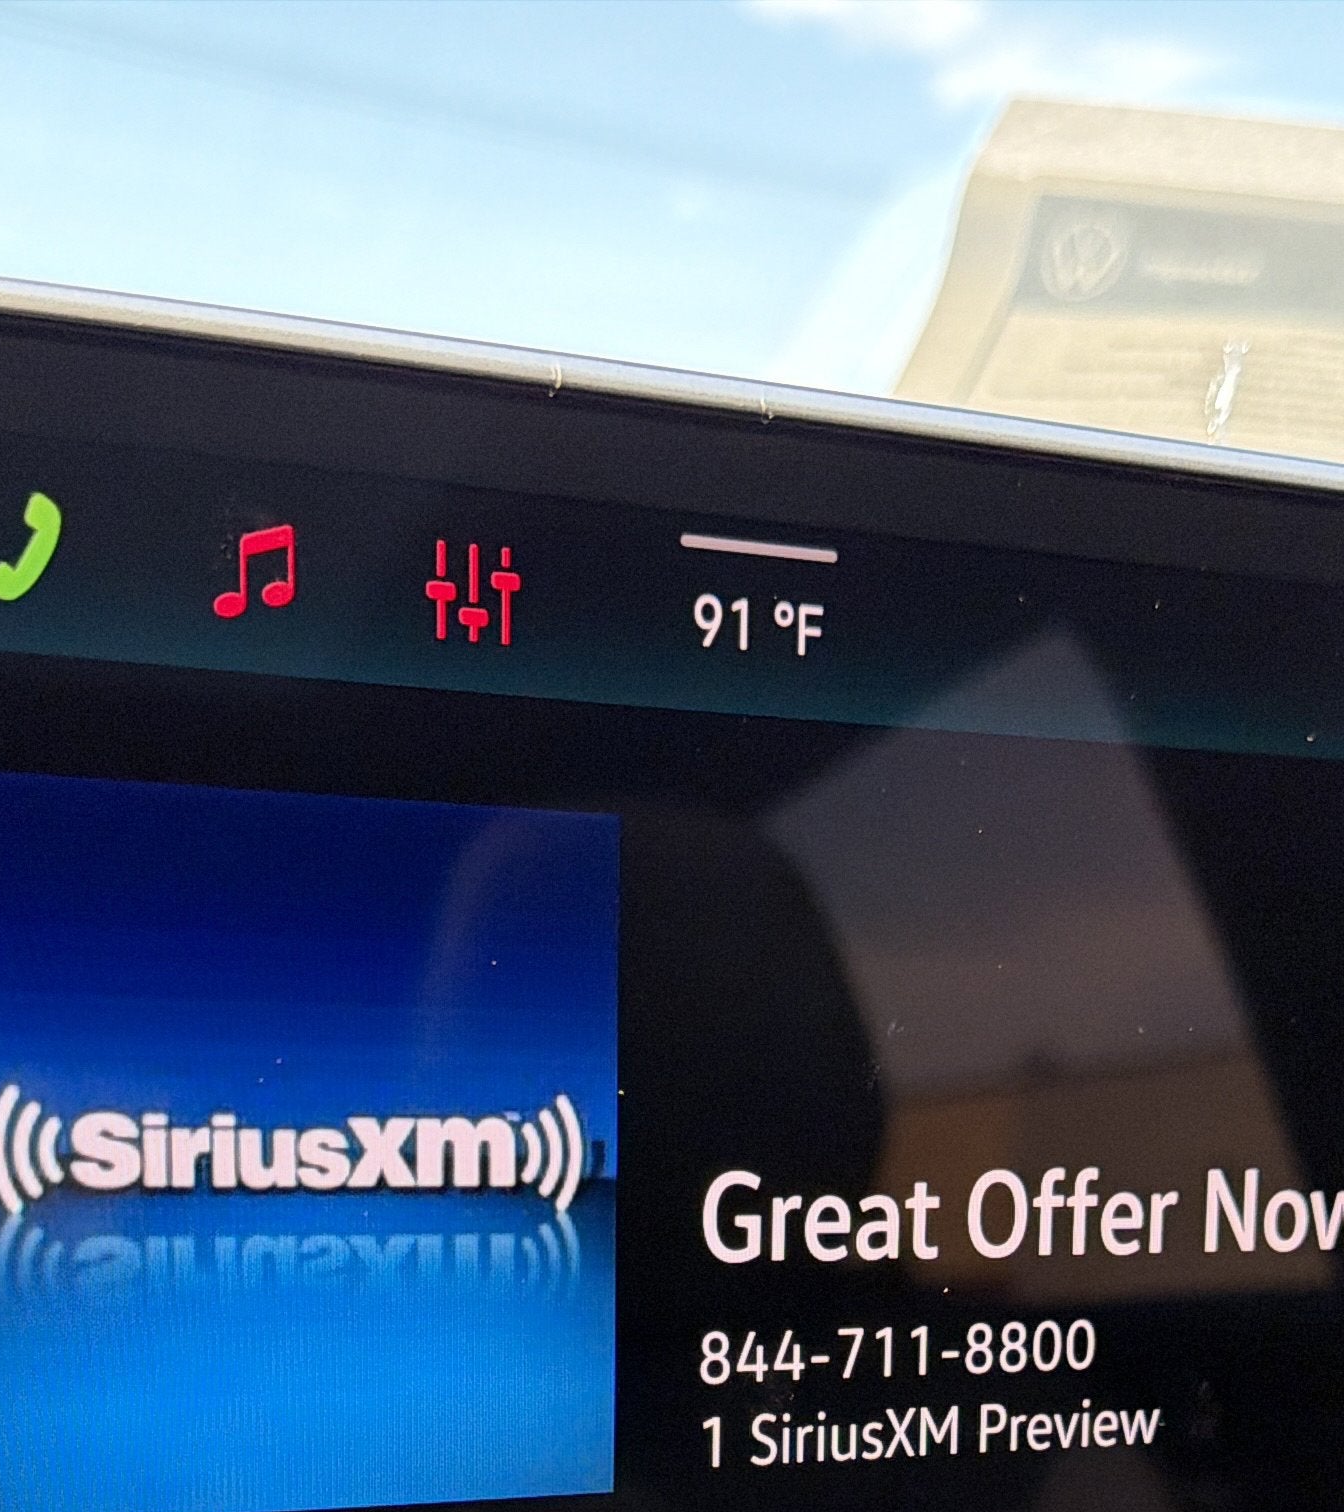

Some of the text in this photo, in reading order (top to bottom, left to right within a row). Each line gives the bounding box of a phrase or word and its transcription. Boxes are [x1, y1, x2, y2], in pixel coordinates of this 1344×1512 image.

[693, 593, 750, 651] 91
[701, 1169, 940, 1264] Great
[966, 1166, 1178, 1258] Offer
[698, 1317, 1096, 1386] 844-711-8800
[702, 1398, 1162, 1468] 1 SiriusXM Preview
